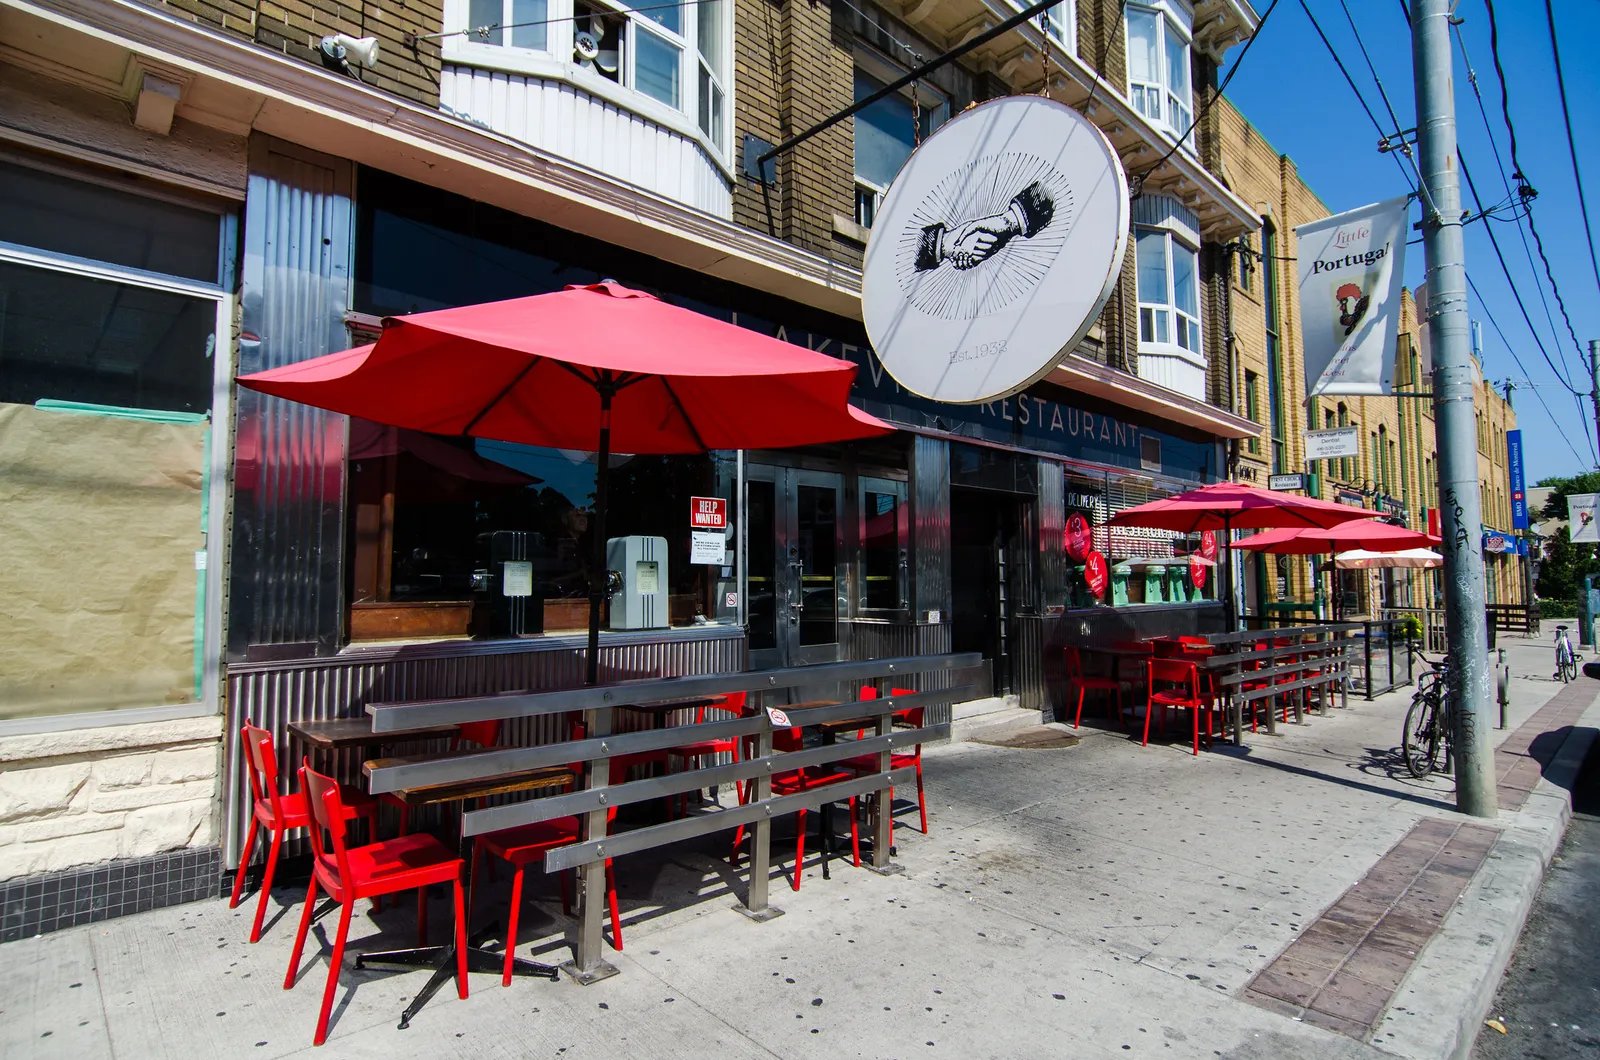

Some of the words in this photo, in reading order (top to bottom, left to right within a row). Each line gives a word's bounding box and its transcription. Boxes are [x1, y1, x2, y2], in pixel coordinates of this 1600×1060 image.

[1333, 227, 1369, 249] Little
[1313, 242, 1390, 274] Portugal
[699, 500, 718, 513] HELP
[1068, 492, 1098, 509] DELIVERY
[695, 513, 722, 525] WANTED
